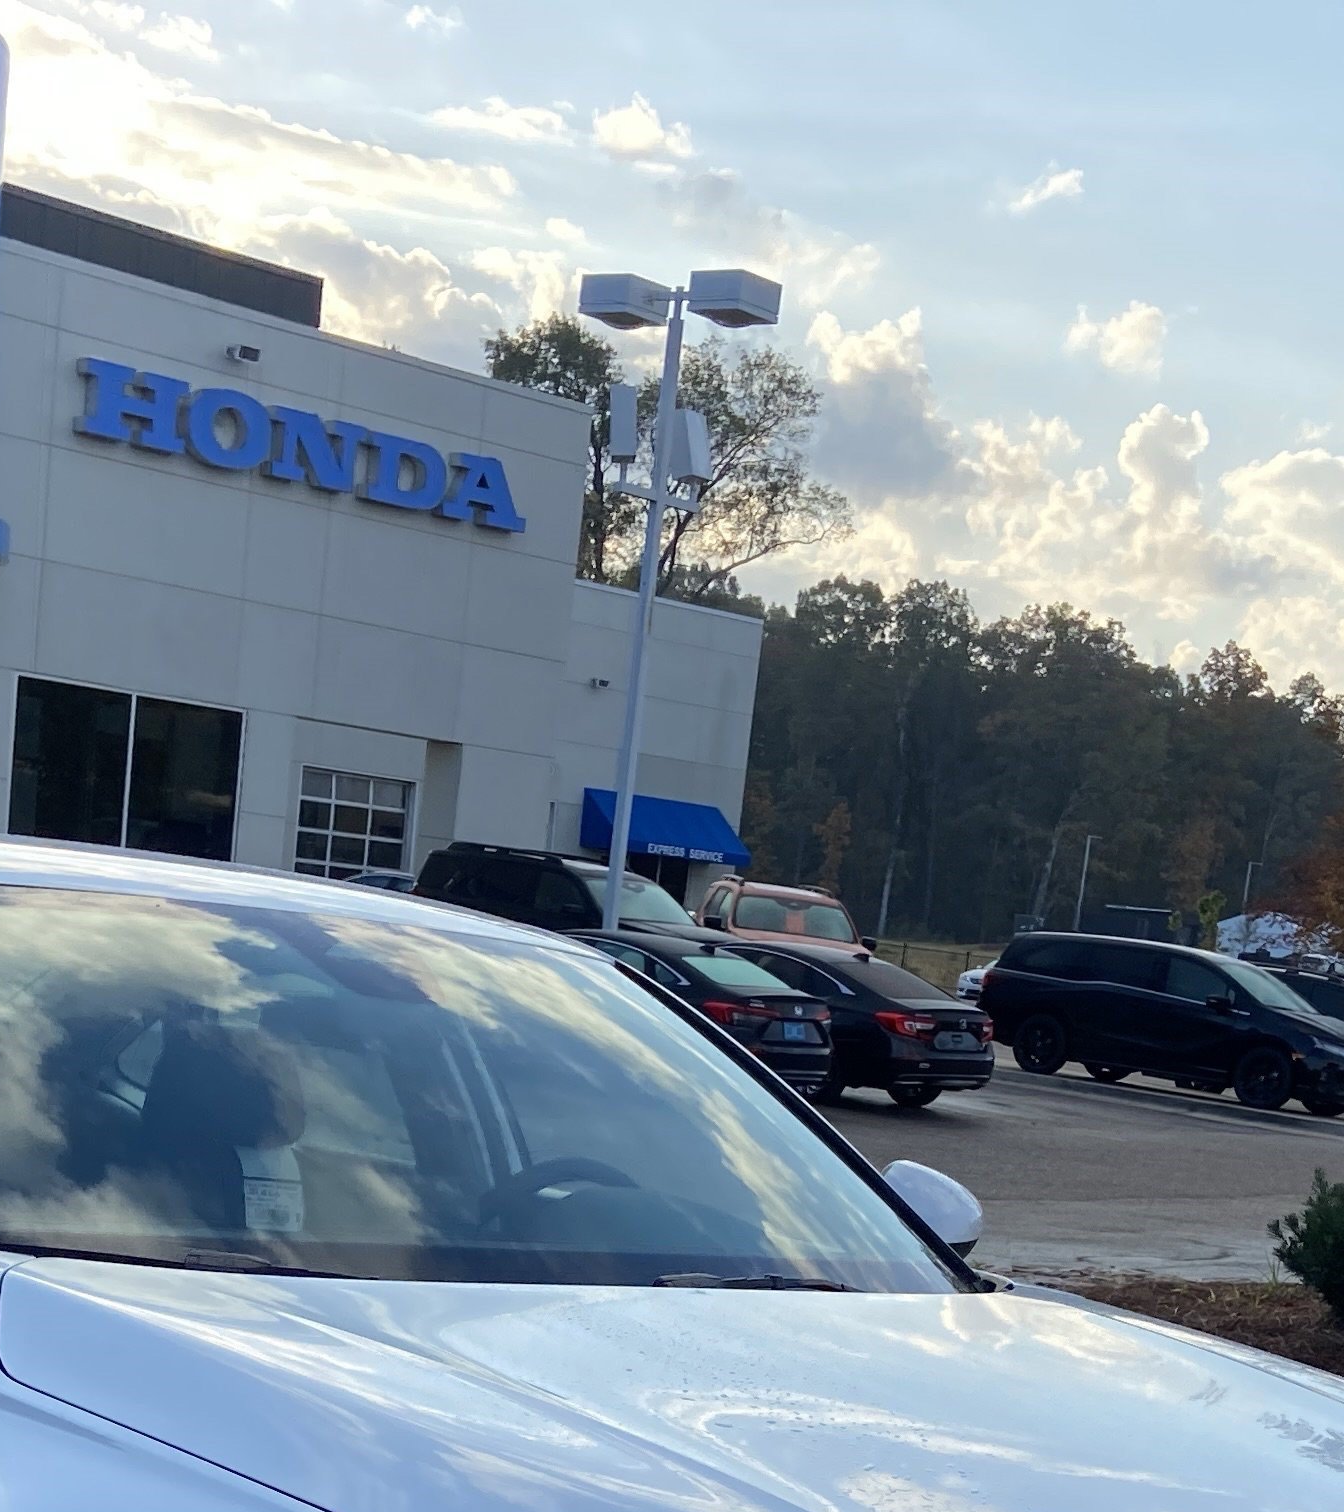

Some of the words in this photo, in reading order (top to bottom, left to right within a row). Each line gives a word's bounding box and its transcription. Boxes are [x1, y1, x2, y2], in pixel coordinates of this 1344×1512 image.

[73, 357, 526, 533] HONDA
[647, 843, 685, 856] EXPRESS
[689, 848, 724, 862] SERVICE
